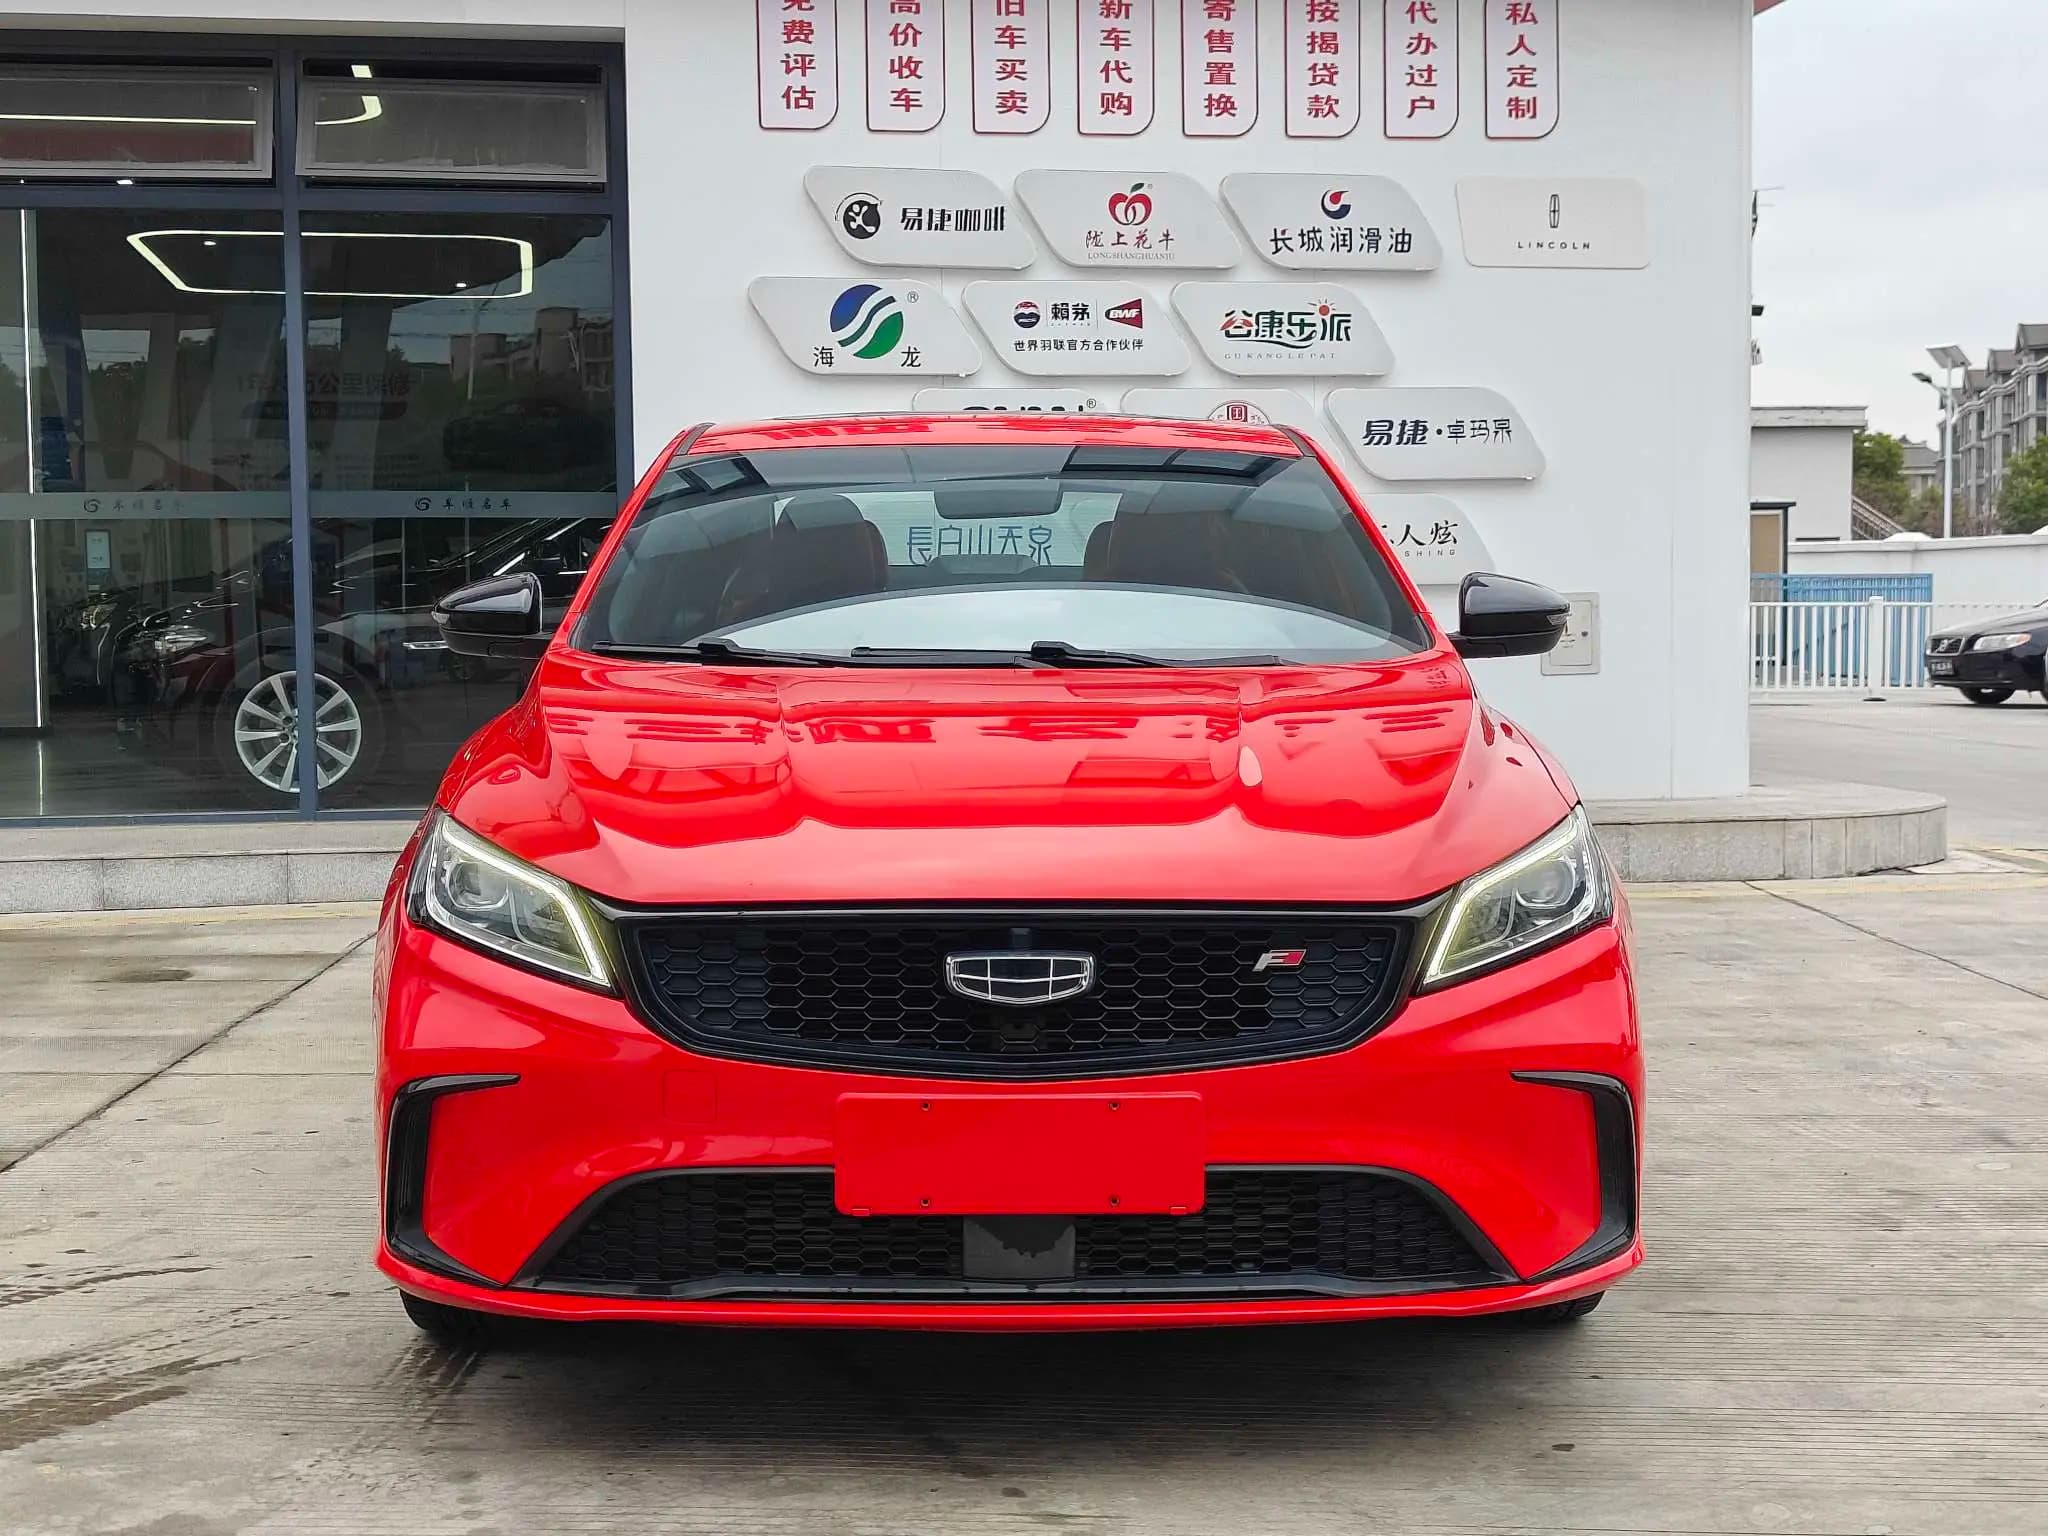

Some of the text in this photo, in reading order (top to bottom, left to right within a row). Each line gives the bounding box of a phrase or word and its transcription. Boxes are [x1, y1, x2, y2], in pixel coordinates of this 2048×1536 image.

[994, 0, 1028, 115] 旧车买卖
[1099, 0, 1133, 117] 新车代购
[1203, 0, 1237, 118] 寄售置换
[1306, 0, 1340, 119] 按揭贷款
[1405, 0, 1438, 119] 代办过户
[1505, 2, 1538, 120] 私人定制
[900, 206, 1005, 232] 易捷咖啡
[1085, 228, 1175, 251] 陇上花牛
[1270, 226, 1412, 255] 长城润滑油
[1517, 241, 1590, 249] LINCOLN
[1108, 308, 1141, 319] BWF
[1220, 309, 1352, 341] 谷康乐派
[1013, 339, 1144, 352] 世界羽联官方合作伙伴
